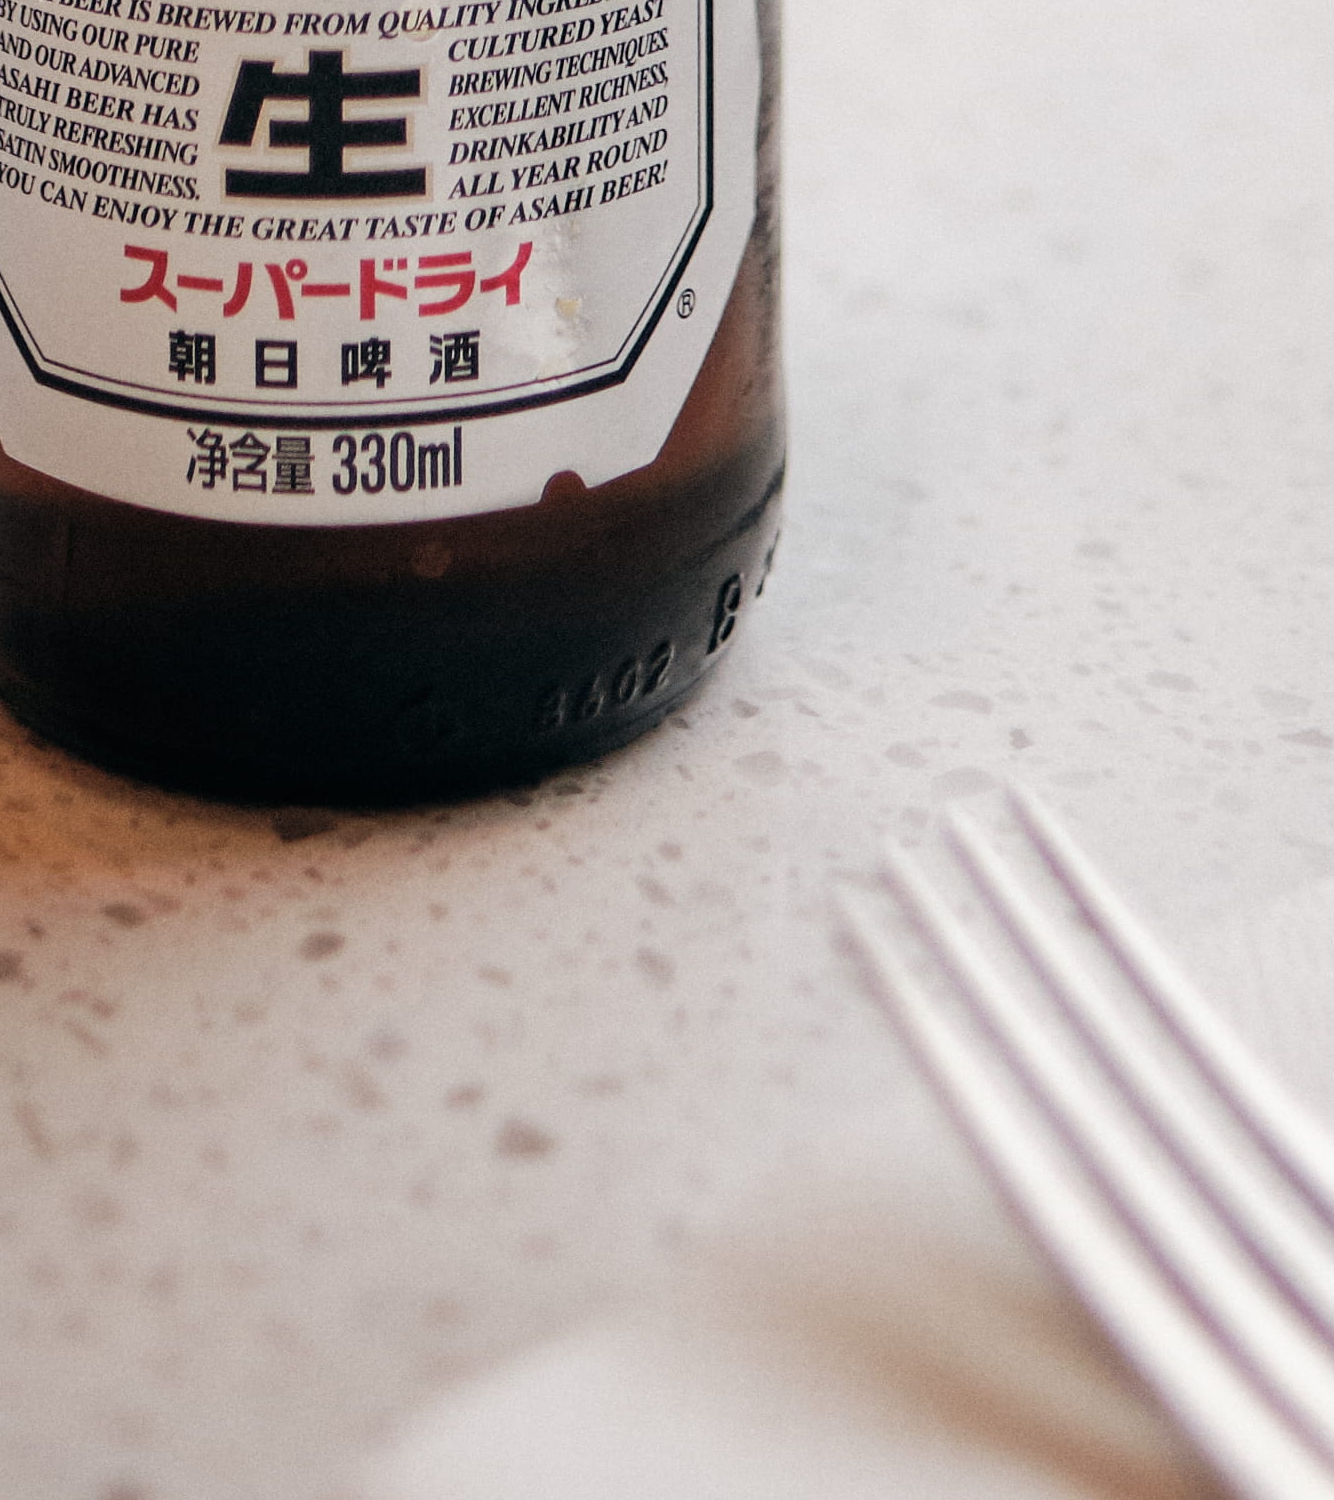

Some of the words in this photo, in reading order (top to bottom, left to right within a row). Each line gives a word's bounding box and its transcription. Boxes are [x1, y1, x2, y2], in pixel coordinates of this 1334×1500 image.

[20, 7, 78, 42] USING
[82, 24, 130, 52] OUR
[135, 33, 200, 63] PURE
[448, 17, 595, 62] CULTURED
[128, 0, 151, 22] IS
[157, 3, 277, 35] BREWED
[283, 12, 371, 36] FROM
[378, 1, 501, 40] QUALITY
[35, 44, 75, 76] OUR
[77, 58, 200, 97] ADVANCED
[448, 60, 551, 97] BREWING
[67, 87, 134, 122] BEER
[141, 104, 199, 132] HAS
[448, 89, 576, 131] EXCELLENT
[578, 61, 669, 111] RICHNESS,
[54, 116, 198, 166] REFRESHING
[448, 109, 624, 165] DRINKABILITY
[625, 95, 668, 129] AND
[216, 47, 430, 202] 生
[48, 149, 200, 200] SMOOTHNESS.
[448, 168, 505, 199] ALL
[512, 156, 581, 190] YEAR
[586, 128, 668, 175] ROUND
[40, 181, 89, 213] CAN
[92, 195, 178, 229] ENJOY
[184, 211, 245, 239] THE
[251, 217, 359, 242] GREAT
[364, 212, 456, 240] TASTE
[464, 205, 506, 232] OF
[508, 186, 594, 226] ASAHI
[600, 160, 669, 205] BEER!
[120, 240, 534, 320] スーパードライ
[185, 426, 316, 495] 净含量
[331, 426, 463, 495] 330ml
